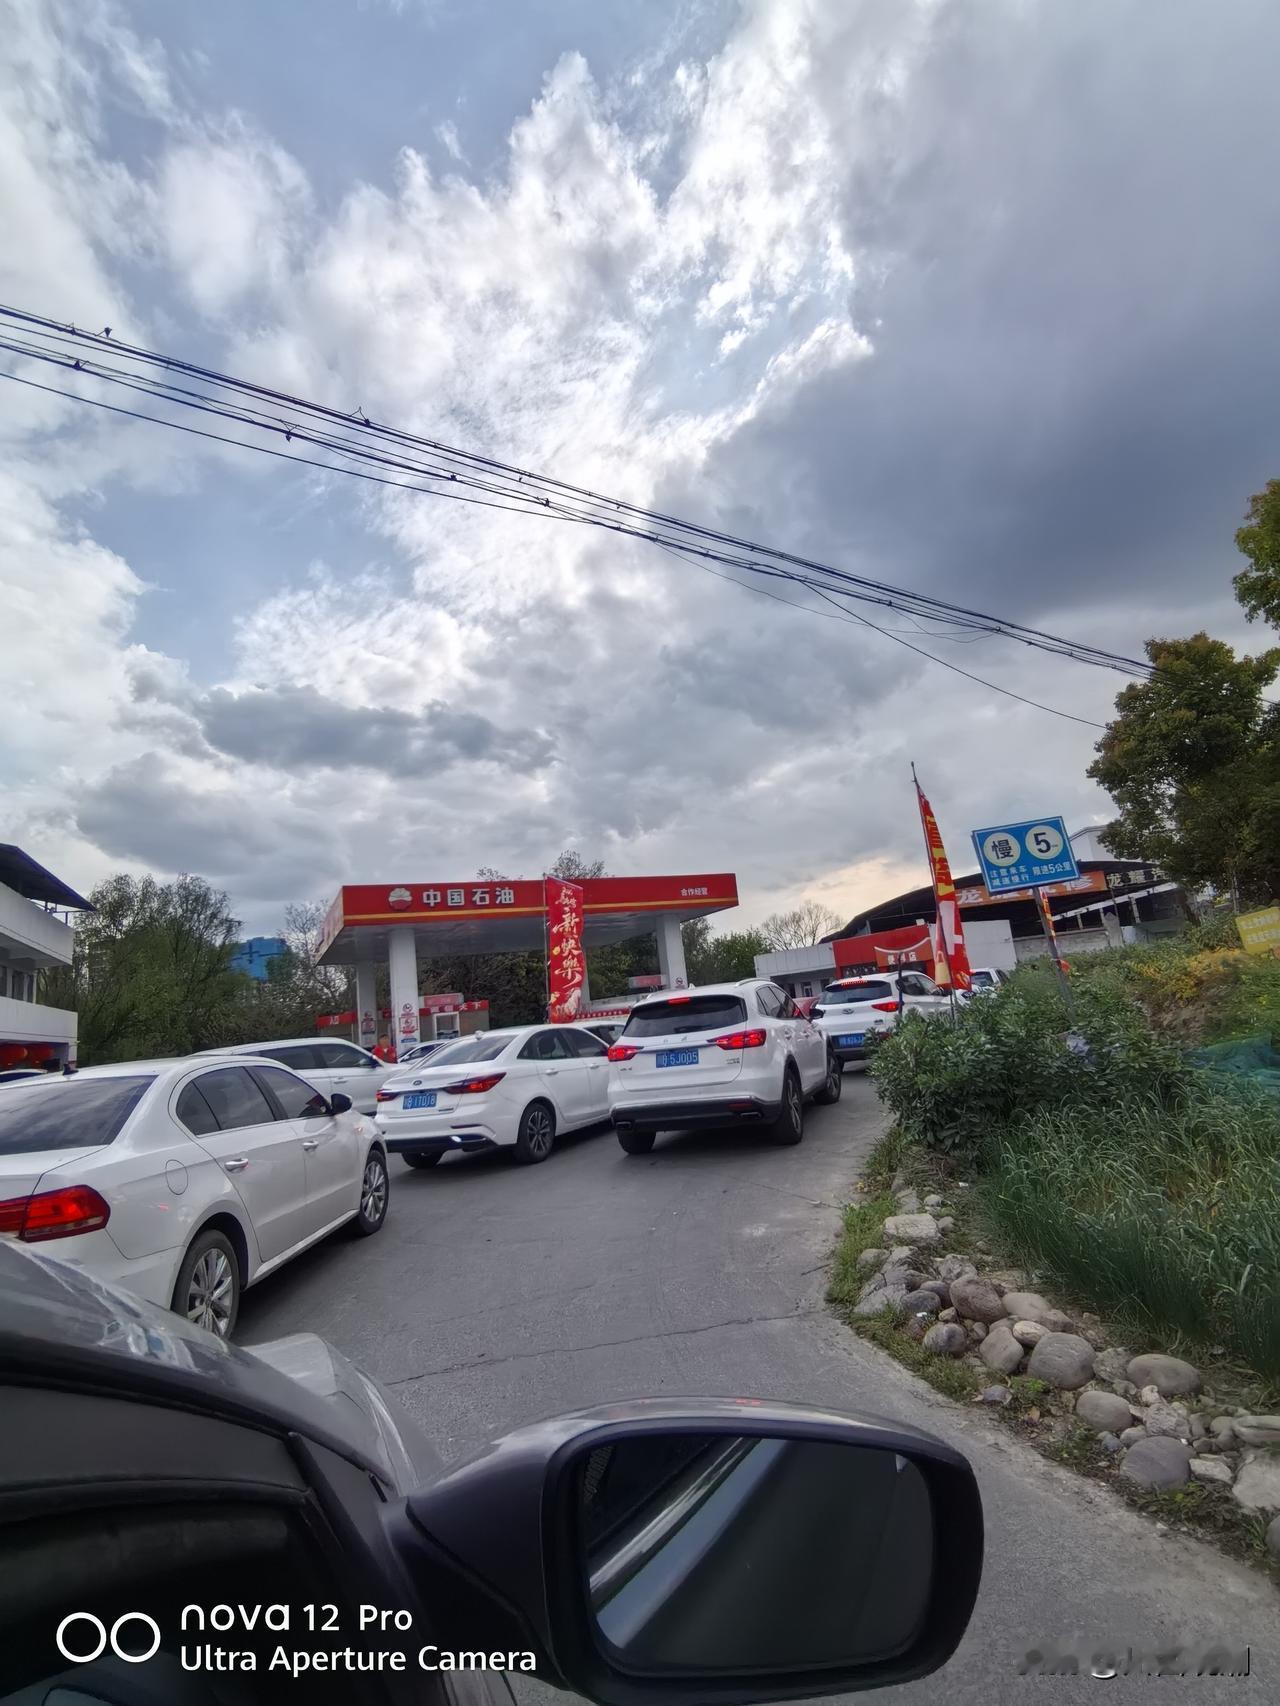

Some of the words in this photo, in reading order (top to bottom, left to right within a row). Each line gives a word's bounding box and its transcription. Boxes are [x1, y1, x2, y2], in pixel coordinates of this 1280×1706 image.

[991, 839, 1014, 860] 慢
[1033, 832, 1051, 854] 5
[422, 887, 515, 907] 中国石油
